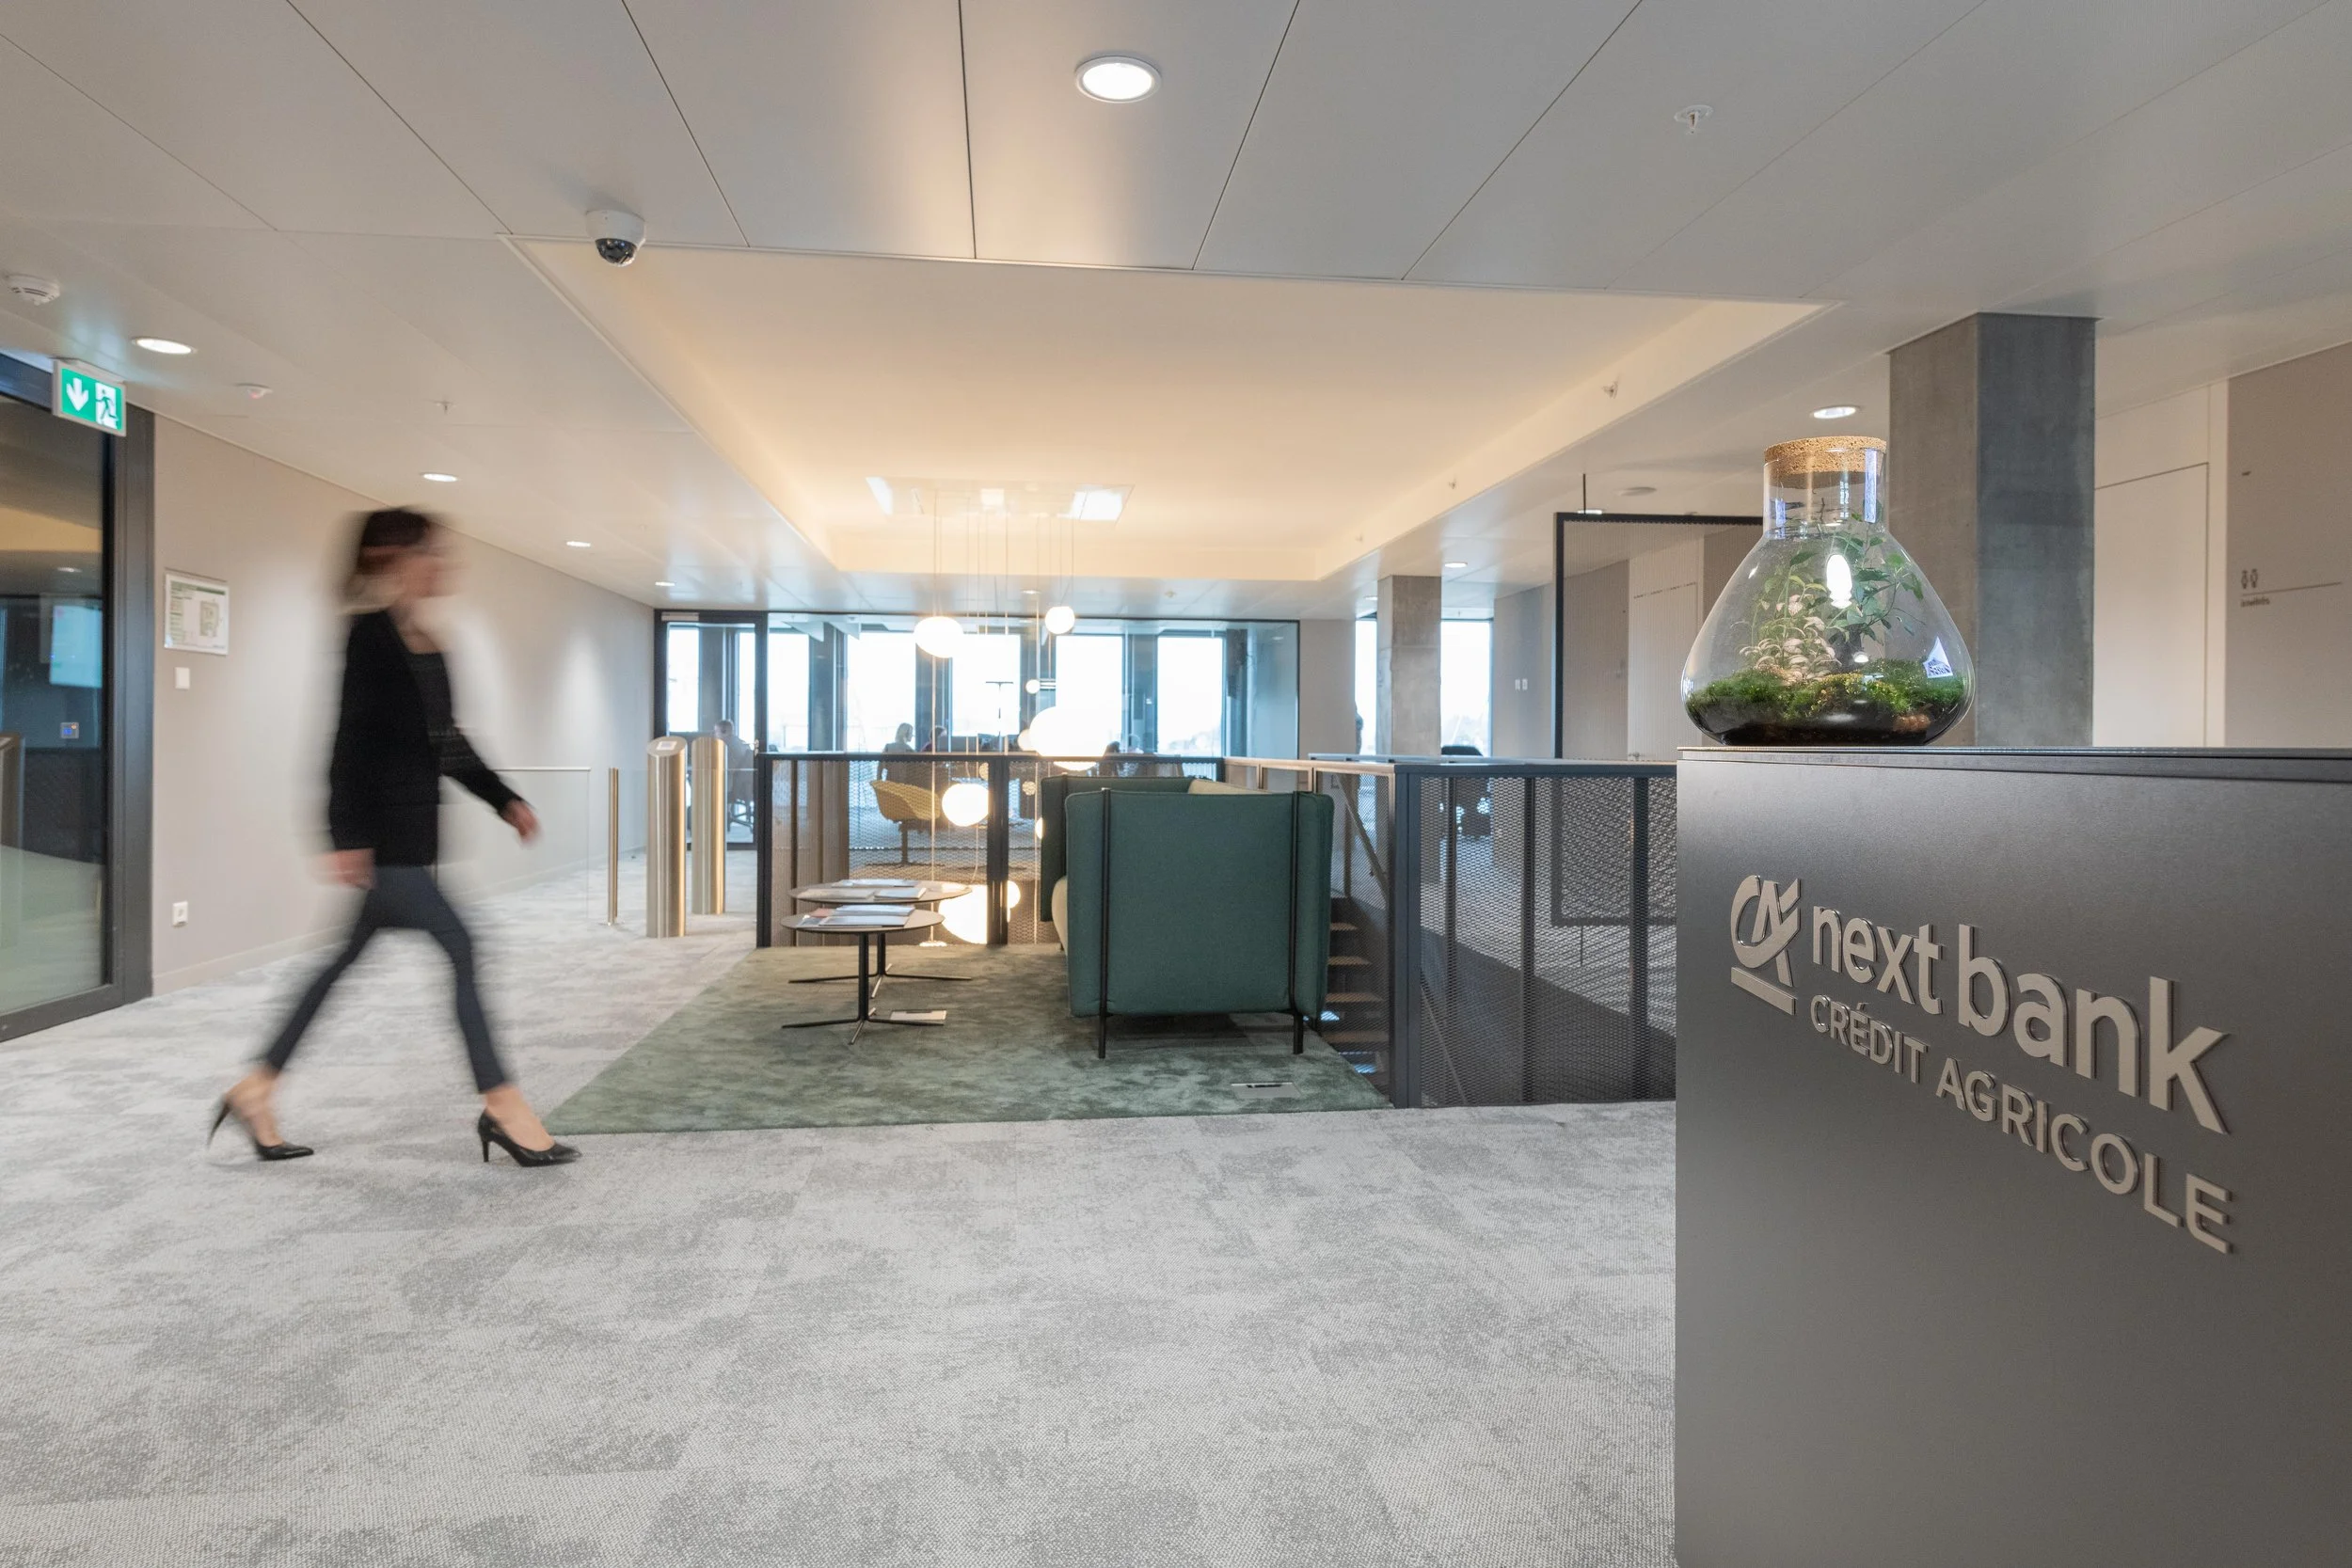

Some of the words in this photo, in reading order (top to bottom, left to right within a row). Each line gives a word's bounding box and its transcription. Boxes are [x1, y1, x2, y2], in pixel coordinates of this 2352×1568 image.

[1810, 994, 1929, 1084] CRÉDIT
[1935, 1057, 2233, 1255] AGRICOLE
[1812, 905, 1944, 1015] next
[1958, 923, 2231, 1135] bank
